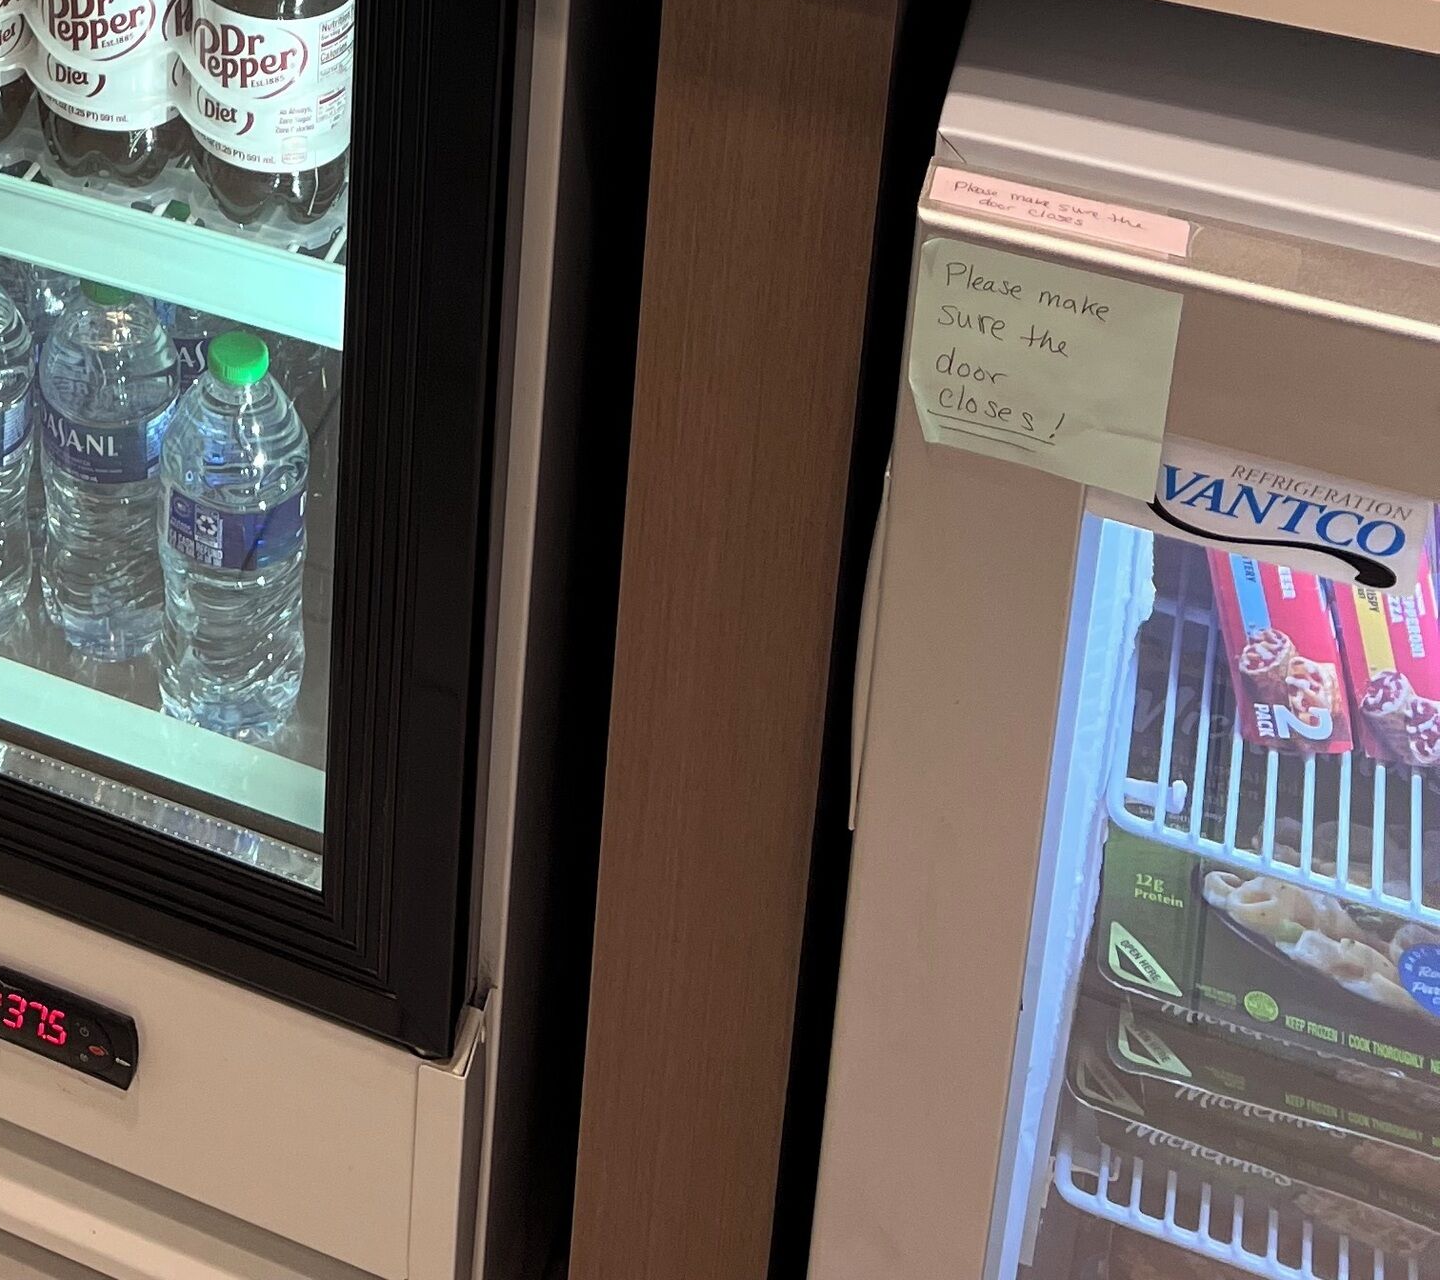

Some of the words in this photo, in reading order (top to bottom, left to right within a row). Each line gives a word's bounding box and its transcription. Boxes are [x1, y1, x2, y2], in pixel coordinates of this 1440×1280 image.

[194, 18, 298, 88] Pepper
[220, 24, 265, 56] Dr
[55, 63, 89, 85] Diet
[204, 98, 238, 123] Diet
[954, 180, 998, 196] Please
[1108, 213, 1144, 229] the
[979, 197, 1012, 211] door
[945, 262, 1022, 300] Please
[1039, 290, 1111, 323] make
[1020, 324, 1069, 358] the
[936, 347, 1009, 384] door
[1232, 464, 1412, 521] REFRIGERATION
[1162, 464, 1406, 558] VANTCO
[1254, 703, 1276, 738] PACK
[1273, 704, 1333, 740] 2
[1134, 887, 1184, 909] Protein
[1136, 873, 1164, 894] 12g
[1120, 939, 1141, 962] OPEN
[1137, 958, 1162, 983] HERE
[3, 993, 68, 1047] 37.5
[1285, 1015, 1305, 1032] KEEP
[1307, 1022, 1338, 1043] FROZEN
[1349, 1034, 1371, 1054] COOK
[1373, 1039, 1424, 1069] THOROUGHLY
